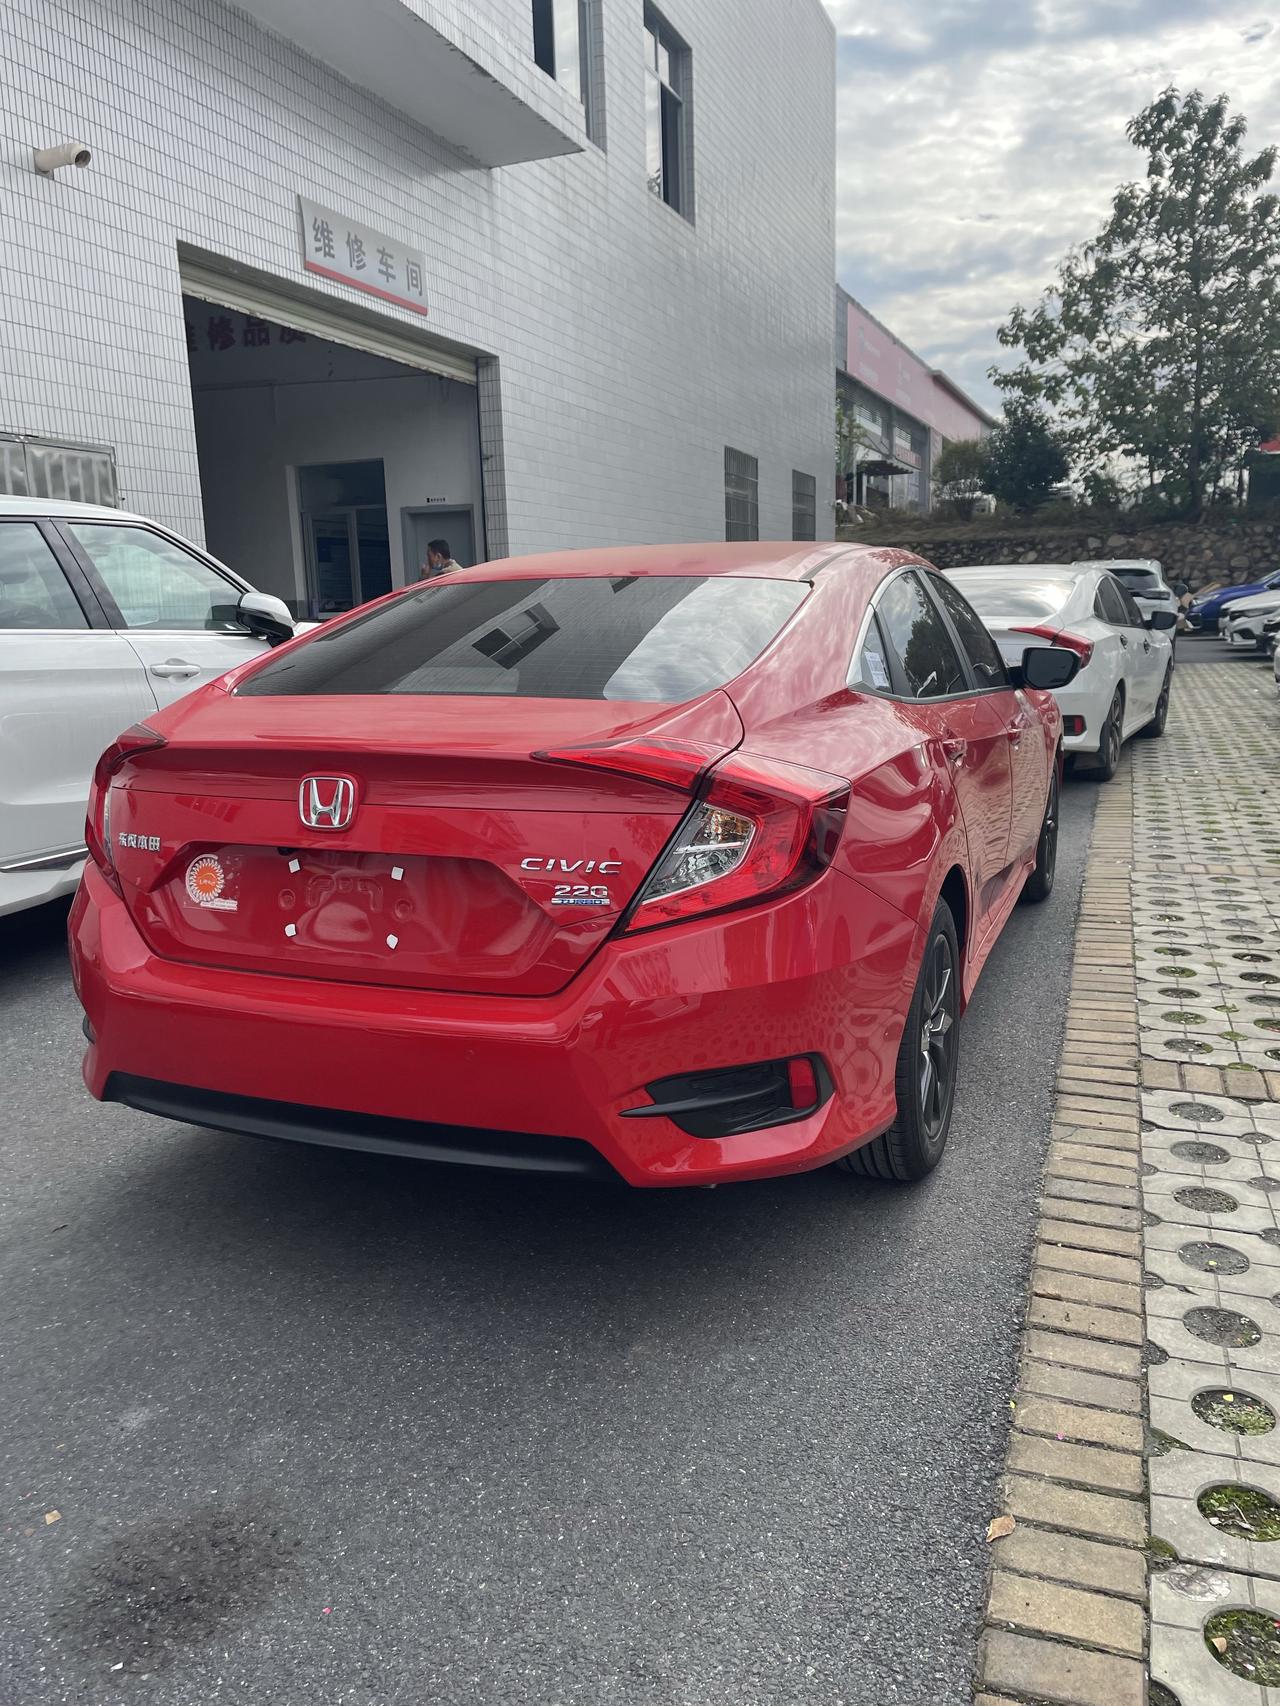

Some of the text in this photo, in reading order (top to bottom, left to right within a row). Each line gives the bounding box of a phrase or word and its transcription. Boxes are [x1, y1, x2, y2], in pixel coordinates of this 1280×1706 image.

[312, 215, 423, 297] 维修车间
[118, 832, 161, 852] 东风本田
[520, 857, 623, 875] CIVIC
[554, 884, 608, 898] 22G
